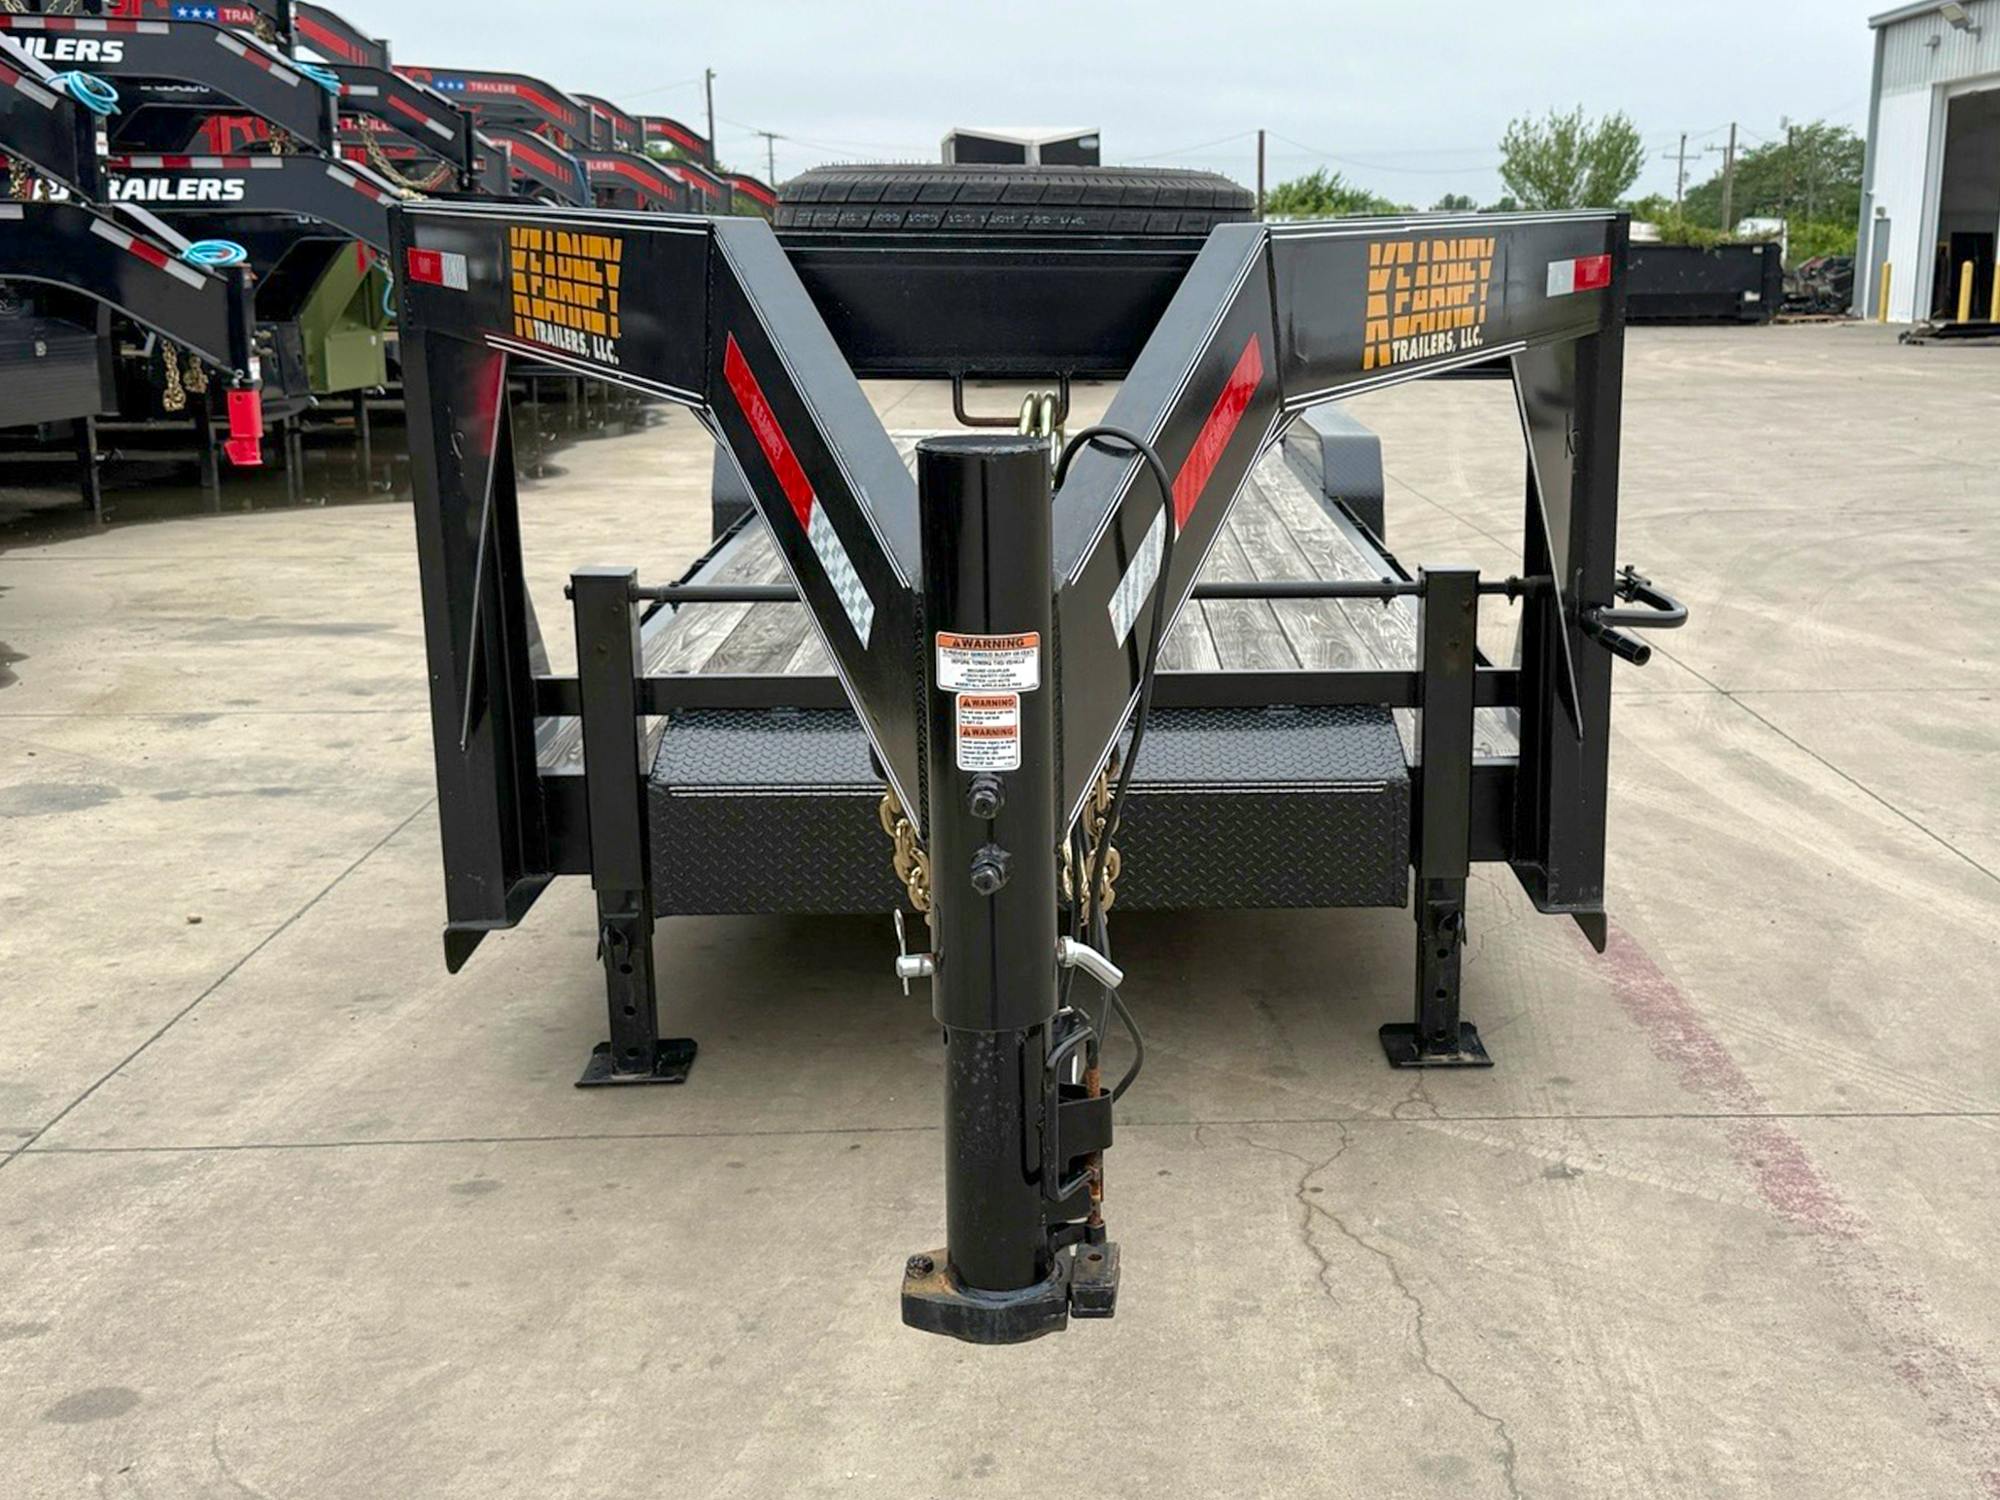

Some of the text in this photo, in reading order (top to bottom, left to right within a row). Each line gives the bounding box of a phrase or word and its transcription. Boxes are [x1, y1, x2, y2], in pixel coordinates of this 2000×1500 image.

[223, 8, 255, 21] TRAI
[20, 36, 125, 63] ILERS
[108, 177, 245, 200] RAILERS
[1459, 325, 1484, 350] LLC.
[592, 335, 620, 366] LLC.
[962, 638, 1025, 650] WARNING
[971, 699, 1015, 708] WARNING
[971, 728, 1014, 737] WARNING
